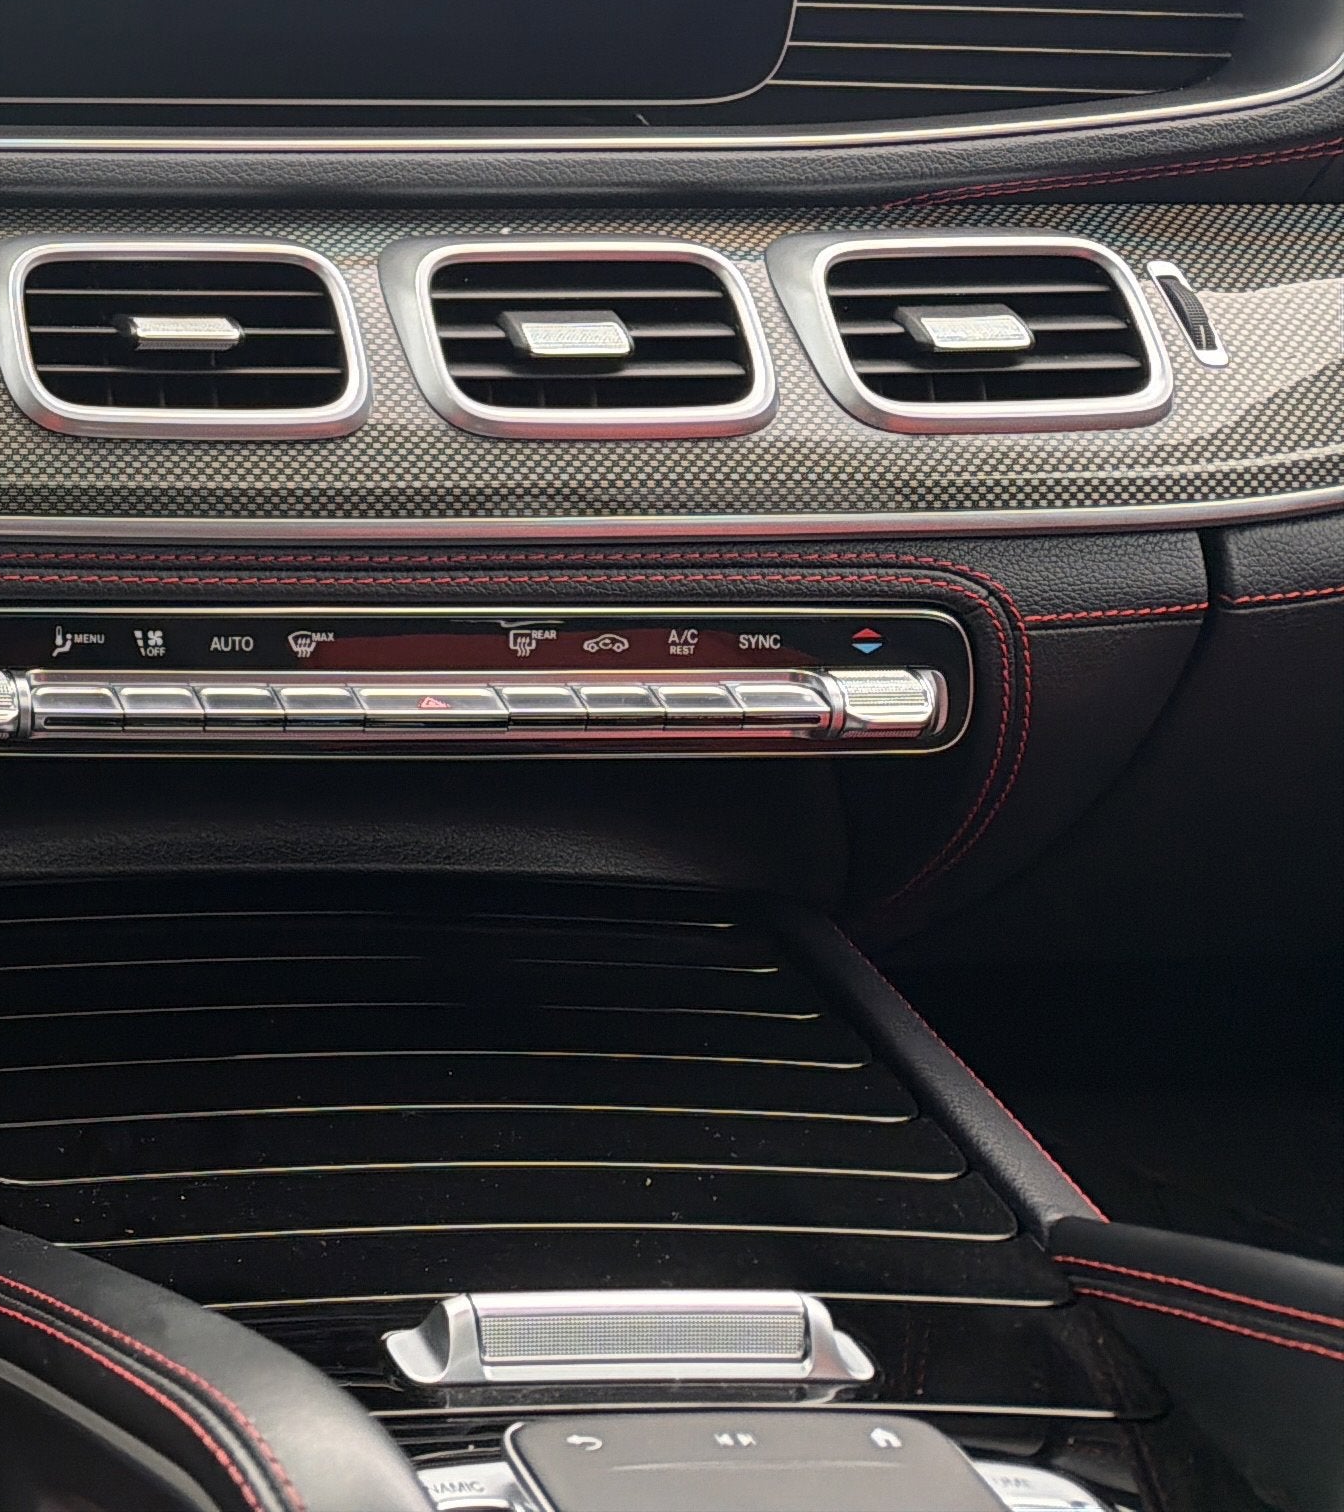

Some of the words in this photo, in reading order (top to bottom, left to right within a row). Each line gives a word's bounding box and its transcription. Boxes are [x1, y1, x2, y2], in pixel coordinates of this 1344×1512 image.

[73, 633, 105, 644] MENU
[312, 632, 335, 642] MAX
[532, 630, 557, 640] REAR
[668, 629, 699, 644] A/C
[210, 636, 254, 652] AUTO
[738, 634, 781, 649] SYNC
[146, 647, 166, 657] OFF
[669, 645, 695, 656] REST
